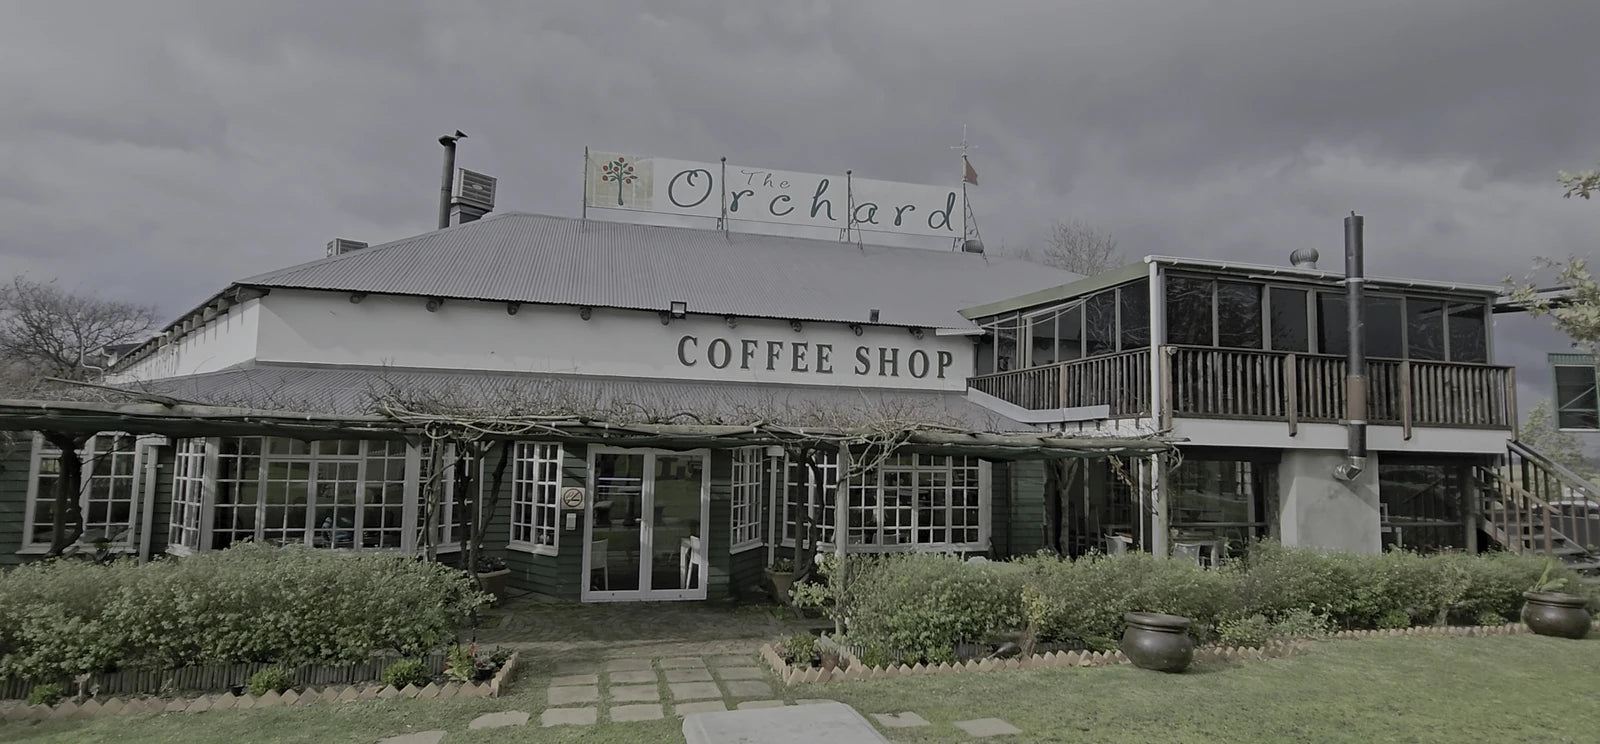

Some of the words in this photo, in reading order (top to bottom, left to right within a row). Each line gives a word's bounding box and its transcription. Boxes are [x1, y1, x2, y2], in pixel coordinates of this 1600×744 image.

[668, 168, 956, 232] Orchard
[741, 169, 791, 189] The
[677, 335, 833, 374] COFFEE
[855, 346, 953, 379] SHOP
